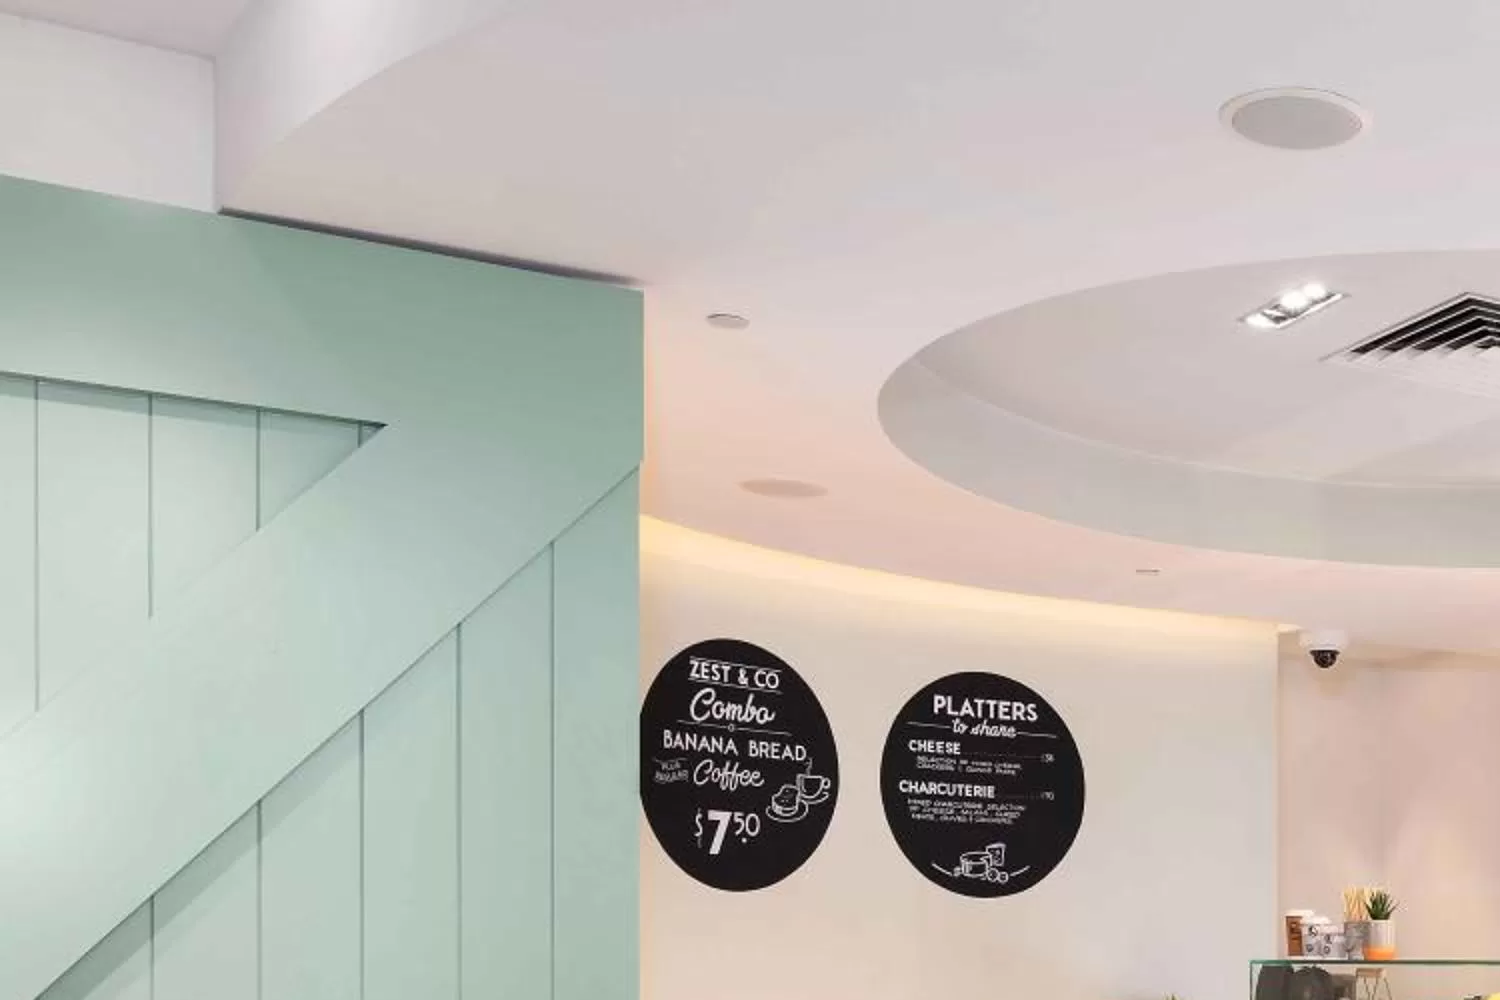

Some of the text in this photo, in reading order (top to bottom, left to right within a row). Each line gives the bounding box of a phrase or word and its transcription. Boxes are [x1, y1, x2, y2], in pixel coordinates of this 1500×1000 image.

[689, 661, 780, 689] ZEST & CO
[689, 688, 776, 724] Combo
[933, 694, 1039, 721] PLATTERS
[952, 718, 1018, 738] to share
[663, 729, 807, 761] BANANA BREAD
[908, 739, 961, 755] CHEESE
[693, 759, 765, 791] Coffee
[899, 780, 995, 799] CHARCUTERIE
